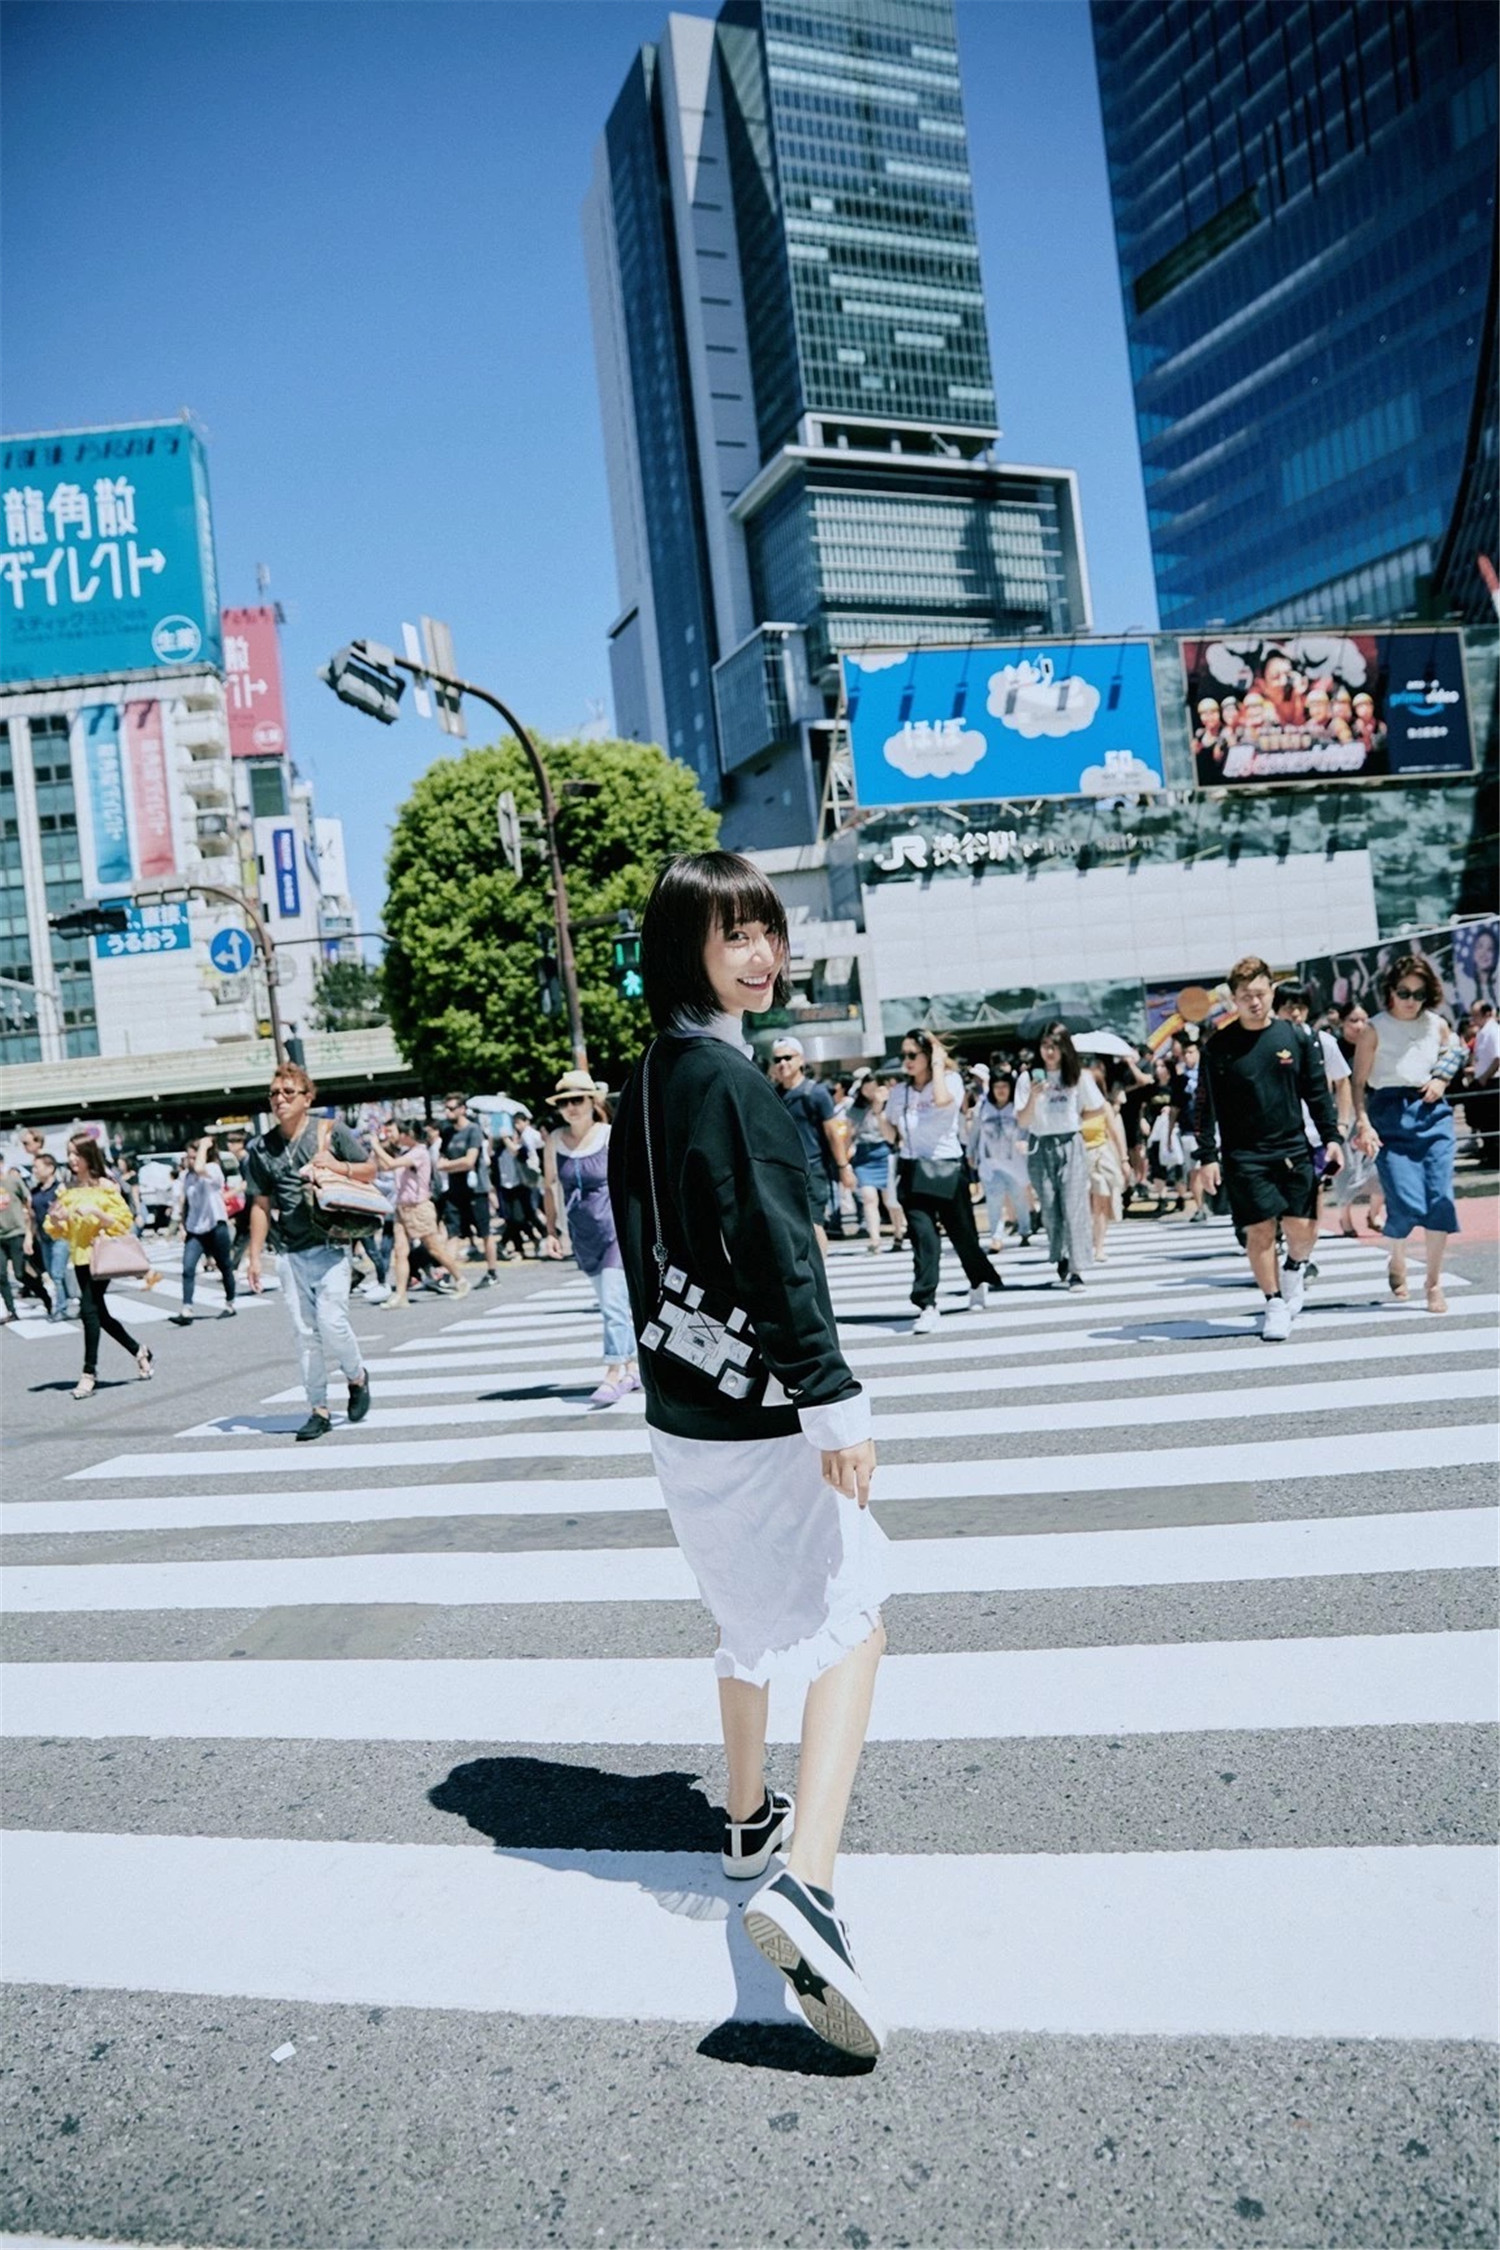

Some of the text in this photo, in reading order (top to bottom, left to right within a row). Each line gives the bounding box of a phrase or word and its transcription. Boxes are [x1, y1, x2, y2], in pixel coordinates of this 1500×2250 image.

[3, 476, 137, 546] 龍角散
[1425, 688, 1460, 704] video
[873, 834, 928, 871] JR
[932, 830, 1018, 866] 渋谷駅
[106, 928, 177, 955] うるおう
